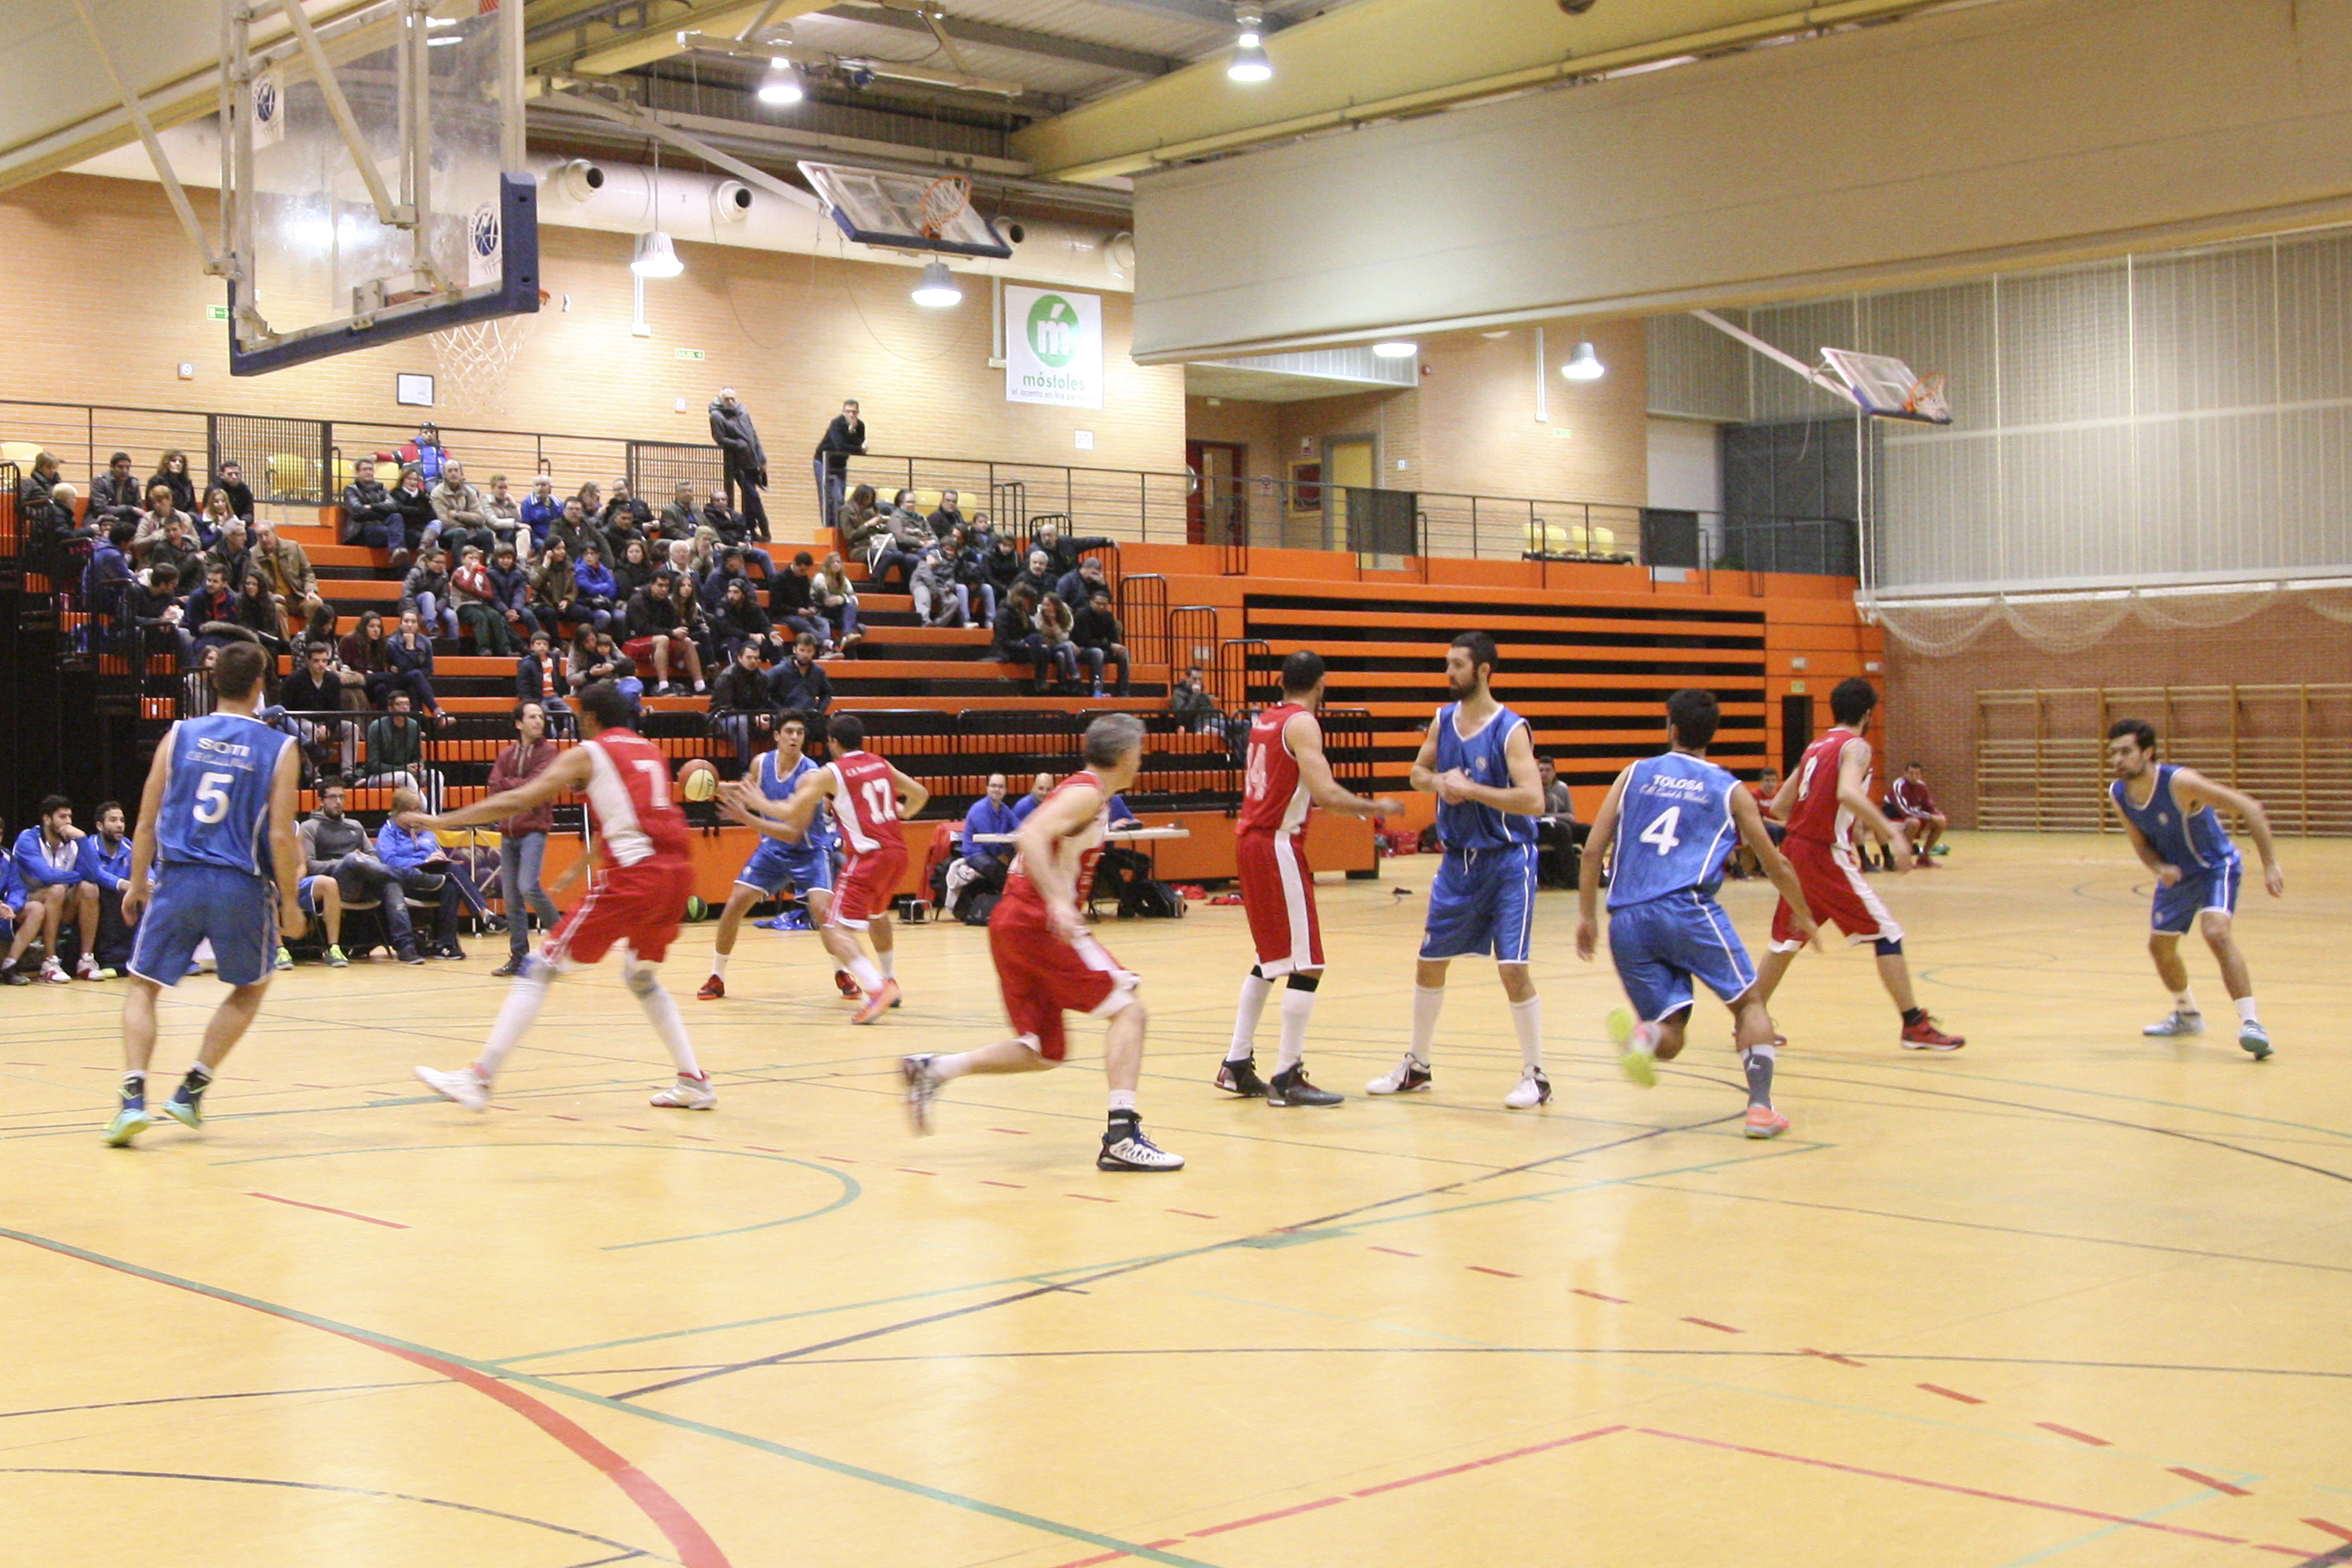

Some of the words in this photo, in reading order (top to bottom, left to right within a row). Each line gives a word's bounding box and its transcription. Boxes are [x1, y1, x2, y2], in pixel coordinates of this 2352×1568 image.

[1023, 371, 1085, 391] móstoles
[631, 760, 671, 811] 7
[1244, 742, 1267, 801] 14
[1653, 774, 1704, 792] TOLOSA
[192, 772, 234, 824] 5
[861, 777, 898, 825] 17
[1639, 806, 1681, 856] 4
